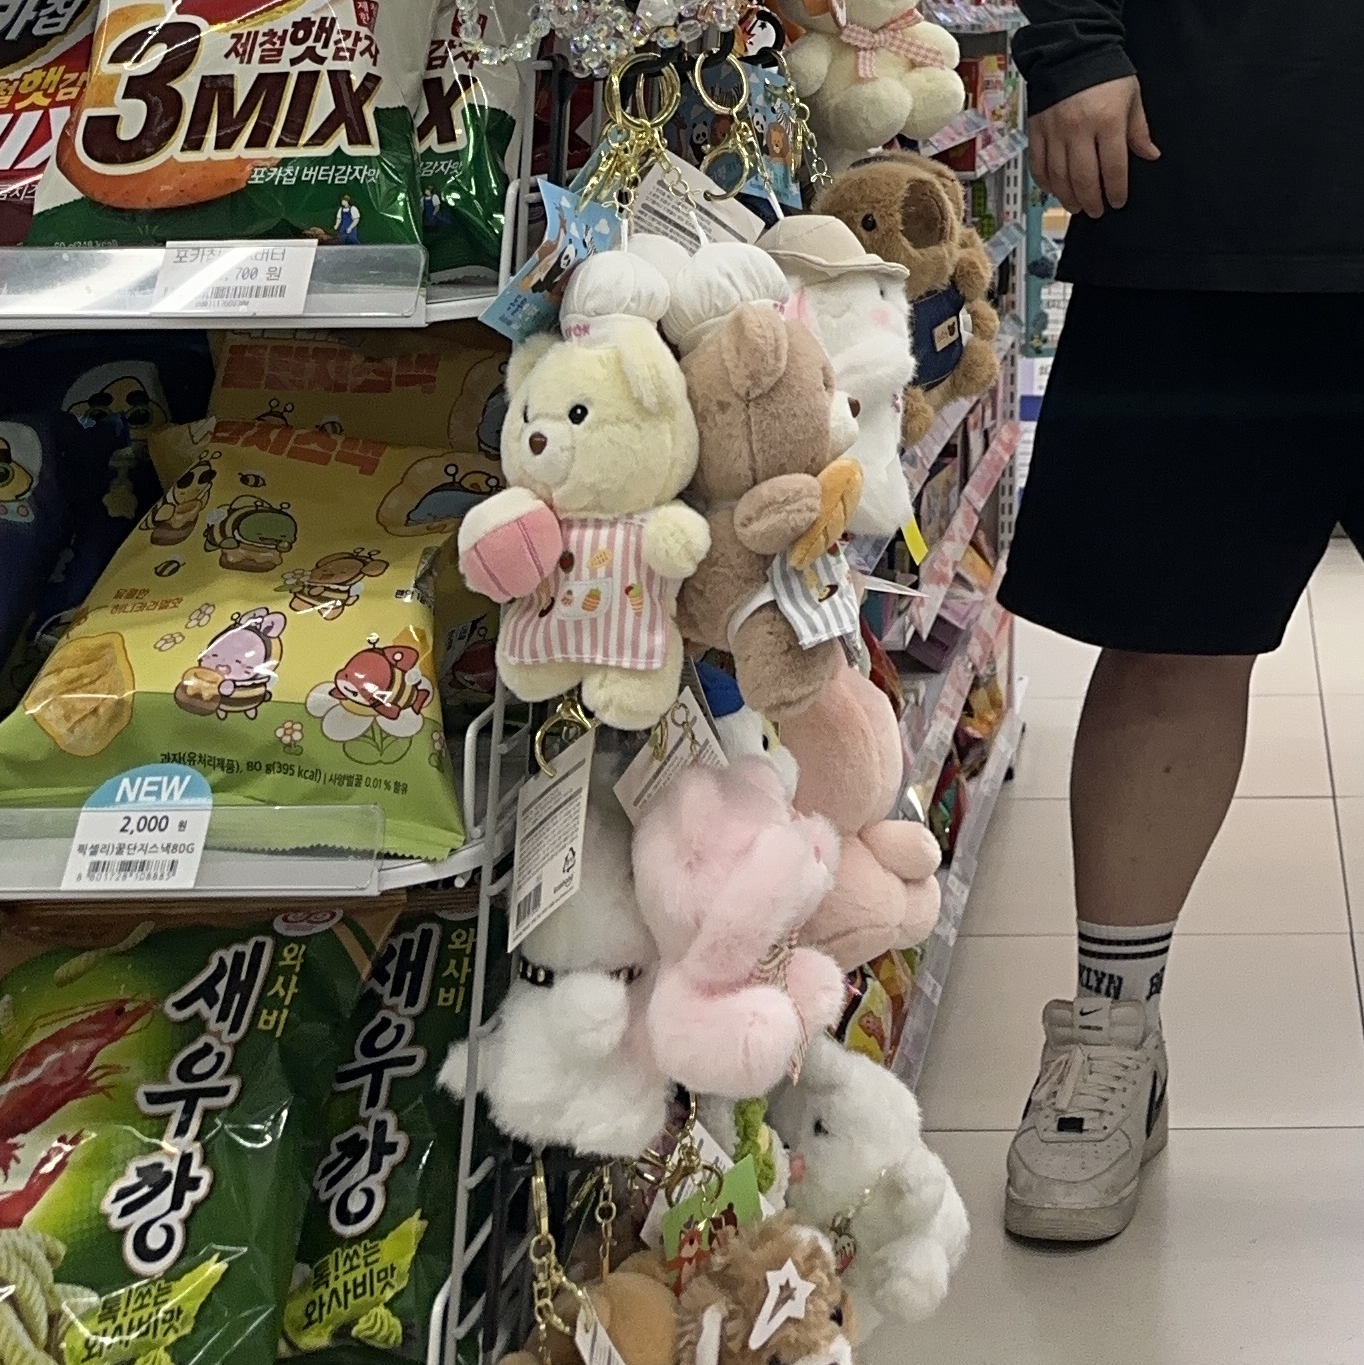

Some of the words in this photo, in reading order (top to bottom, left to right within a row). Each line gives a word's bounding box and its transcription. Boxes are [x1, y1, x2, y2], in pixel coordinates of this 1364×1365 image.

[81, 20, 381, 168] 3MIX
[248, 166, 298, 186] 포카칩
[300, 164, 380, 186] 버터감자맛
[265, 266, 282, 282] 원
[115, 775, 191, 802] NEW
[247, 760, 262, 772] 80
[119, 814, 169, 836] 2,000
[177, 819, 188, 833] 원
[258, 942, 304, 1038] 와사비
[436, 927, 478, 1014] 와사비
[105, 938, 272, 1273] 새우깡
[319, 924, 440, 1235] 새우깡
[301, 1265, 400, 1331] 와사비맛
